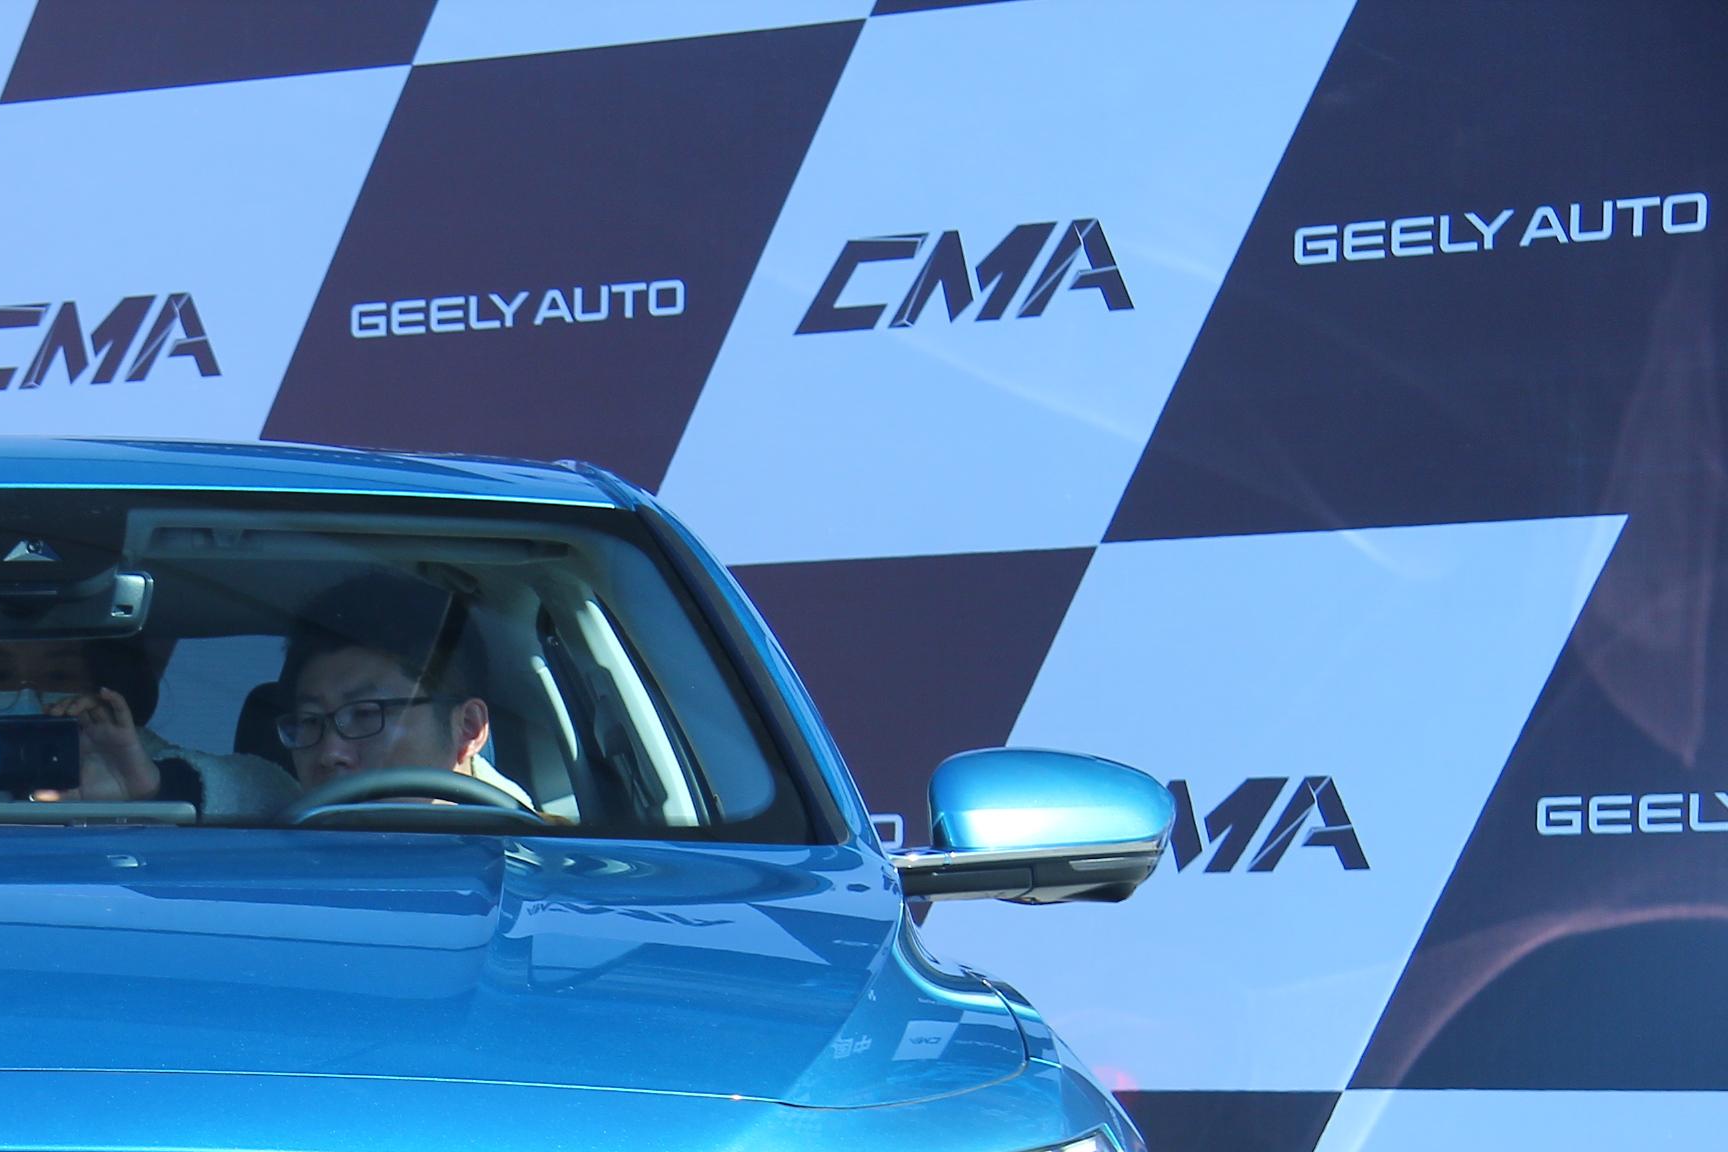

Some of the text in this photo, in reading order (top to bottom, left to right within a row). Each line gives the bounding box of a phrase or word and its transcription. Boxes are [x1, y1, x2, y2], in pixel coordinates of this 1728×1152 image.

[1293, 191, 1709, 267] GEELY AUTO
[350, 277, 686, 339] GEELY AUTO
[793, 217, 1136, 335] CMA
[1166, 776, 1371, 874] MA
[1536, 792, 1728, 836] GEEL
